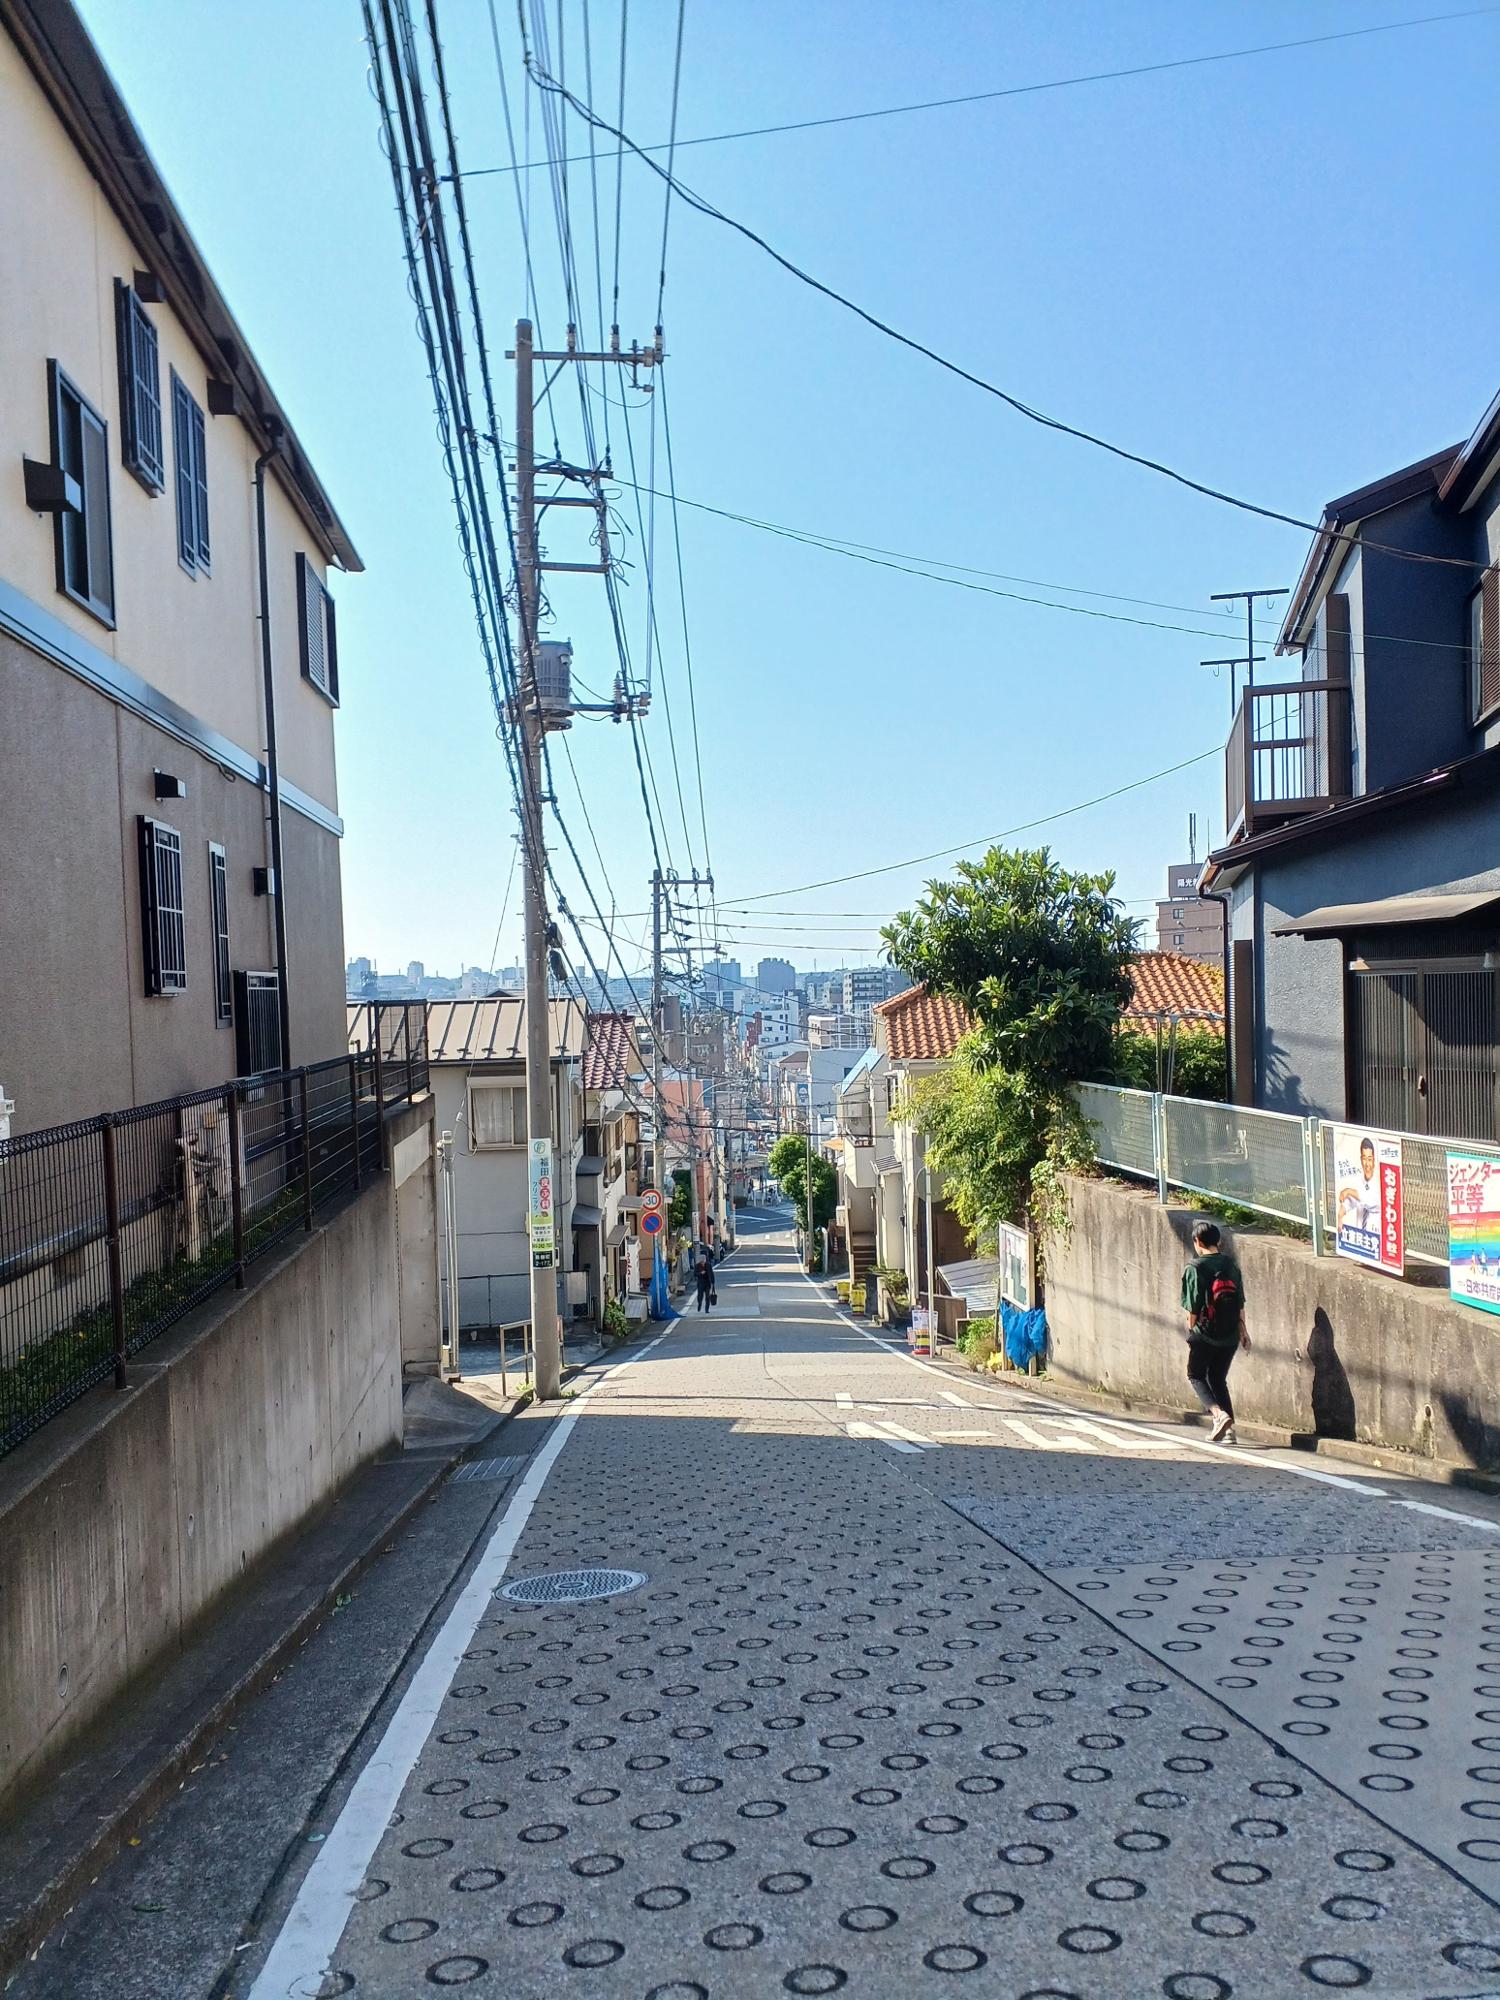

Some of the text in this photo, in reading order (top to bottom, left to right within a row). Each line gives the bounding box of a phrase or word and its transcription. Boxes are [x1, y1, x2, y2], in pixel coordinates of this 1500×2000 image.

[1450, 1161, 1500, 1183] ジェンダー
[645, 1195, 658, 1206] 30
[1451, 1183, 1484, 1213] 平等
